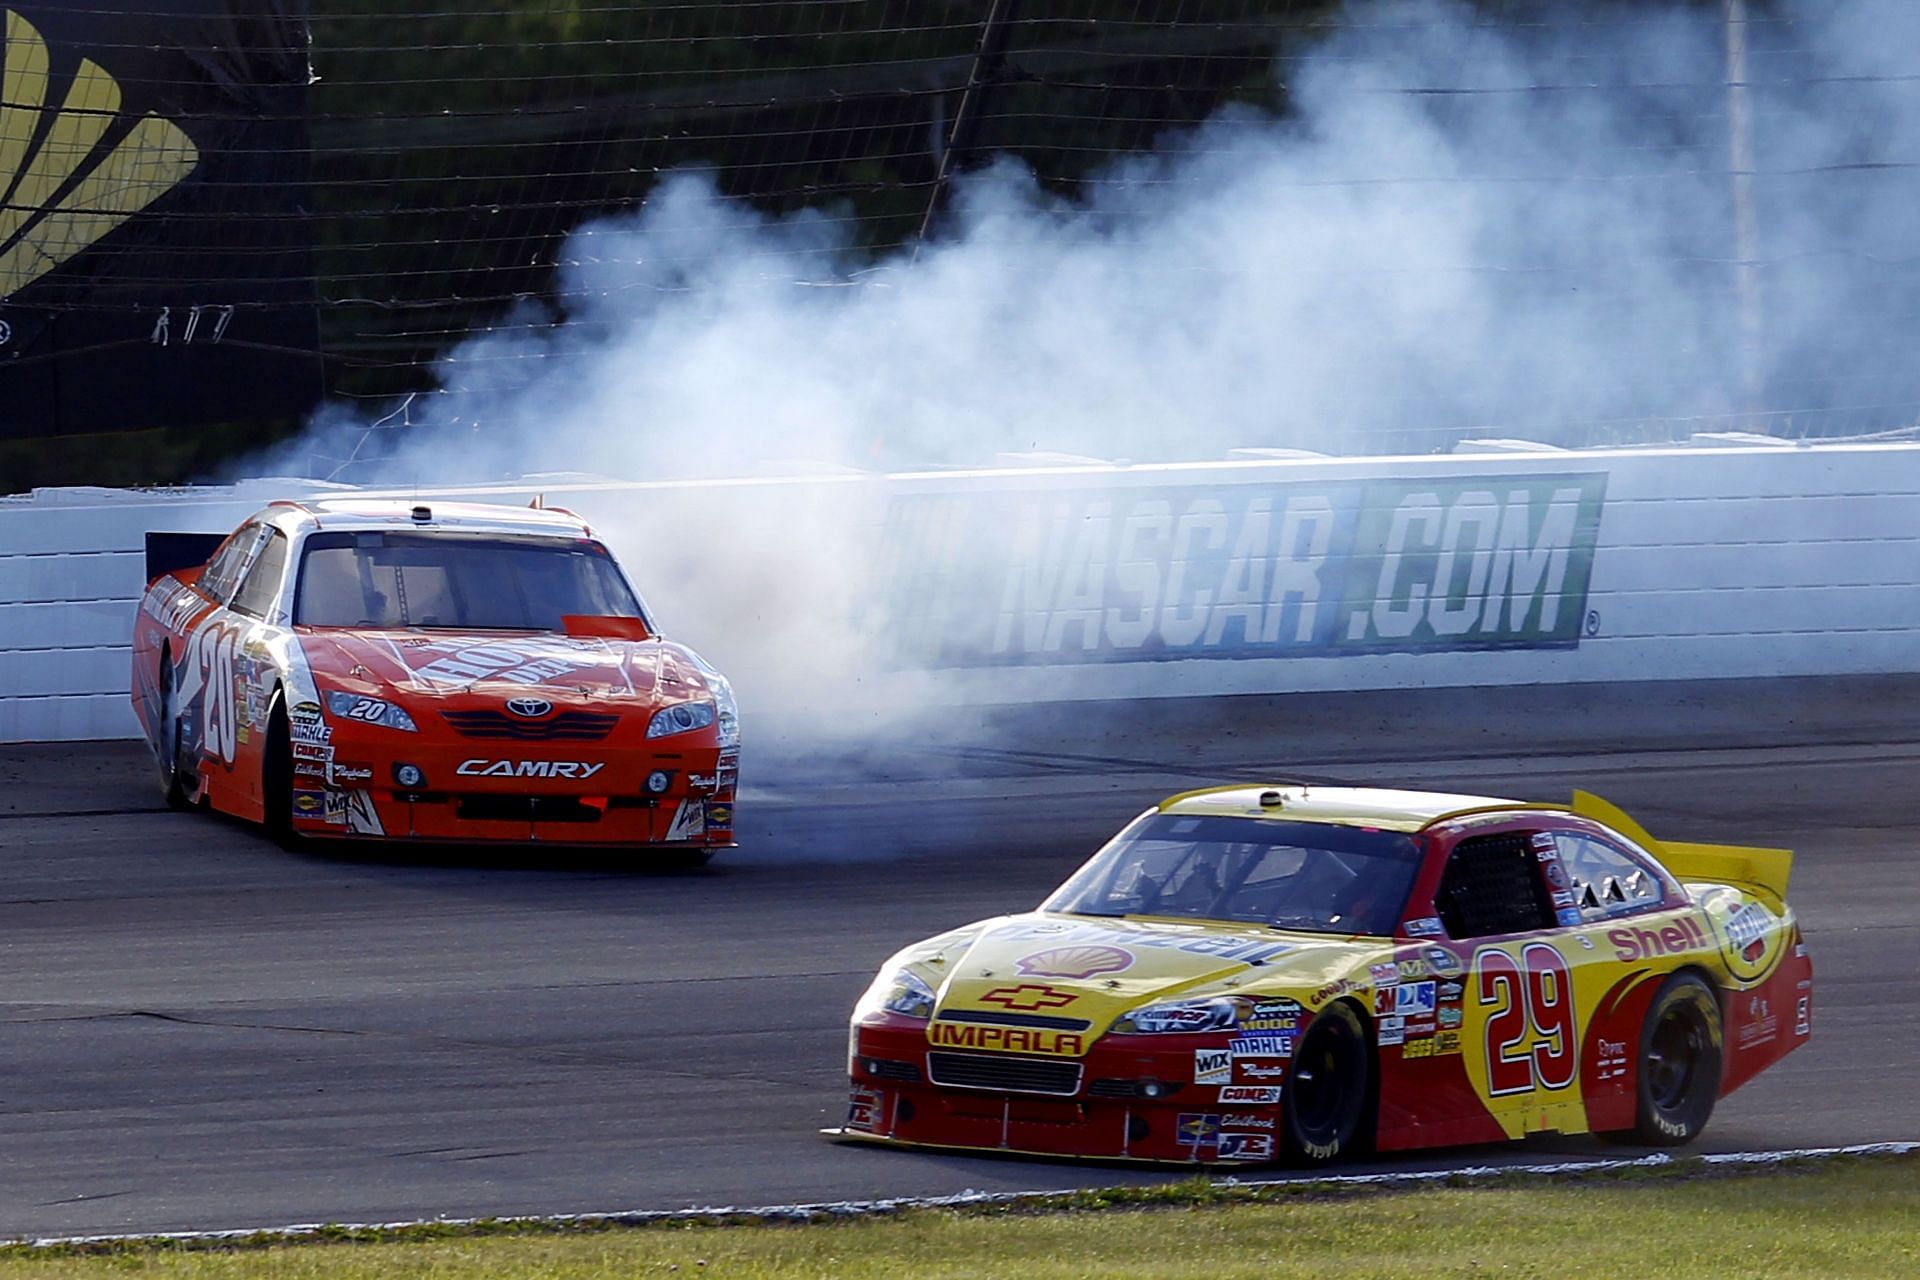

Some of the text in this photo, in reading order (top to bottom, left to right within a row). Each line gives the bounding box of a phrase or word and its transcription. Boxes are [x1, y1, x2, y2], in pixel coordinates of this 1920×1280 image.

[993, 488, 1583, 653] NASCAR.COM
[202, 628, 236, 764] 20
[346, 700, 388, 721] 20
[455, 758, 607, 780] CAMRY
[1609, 917, 1706, 963] Shell
[1376, 988, 1397, 1015] 3M
[1239, 1017, 1296, 1031] MOOG
[1477, 942, 1580, 1098] 29
[932, 1022, 1083, 1055] IMPALA
[1231, 1037, 1293, 1054] MAHLE
[1196, 1052, 1230, 1072] WIX
[1220, 1134, 1269, 1156] JE
